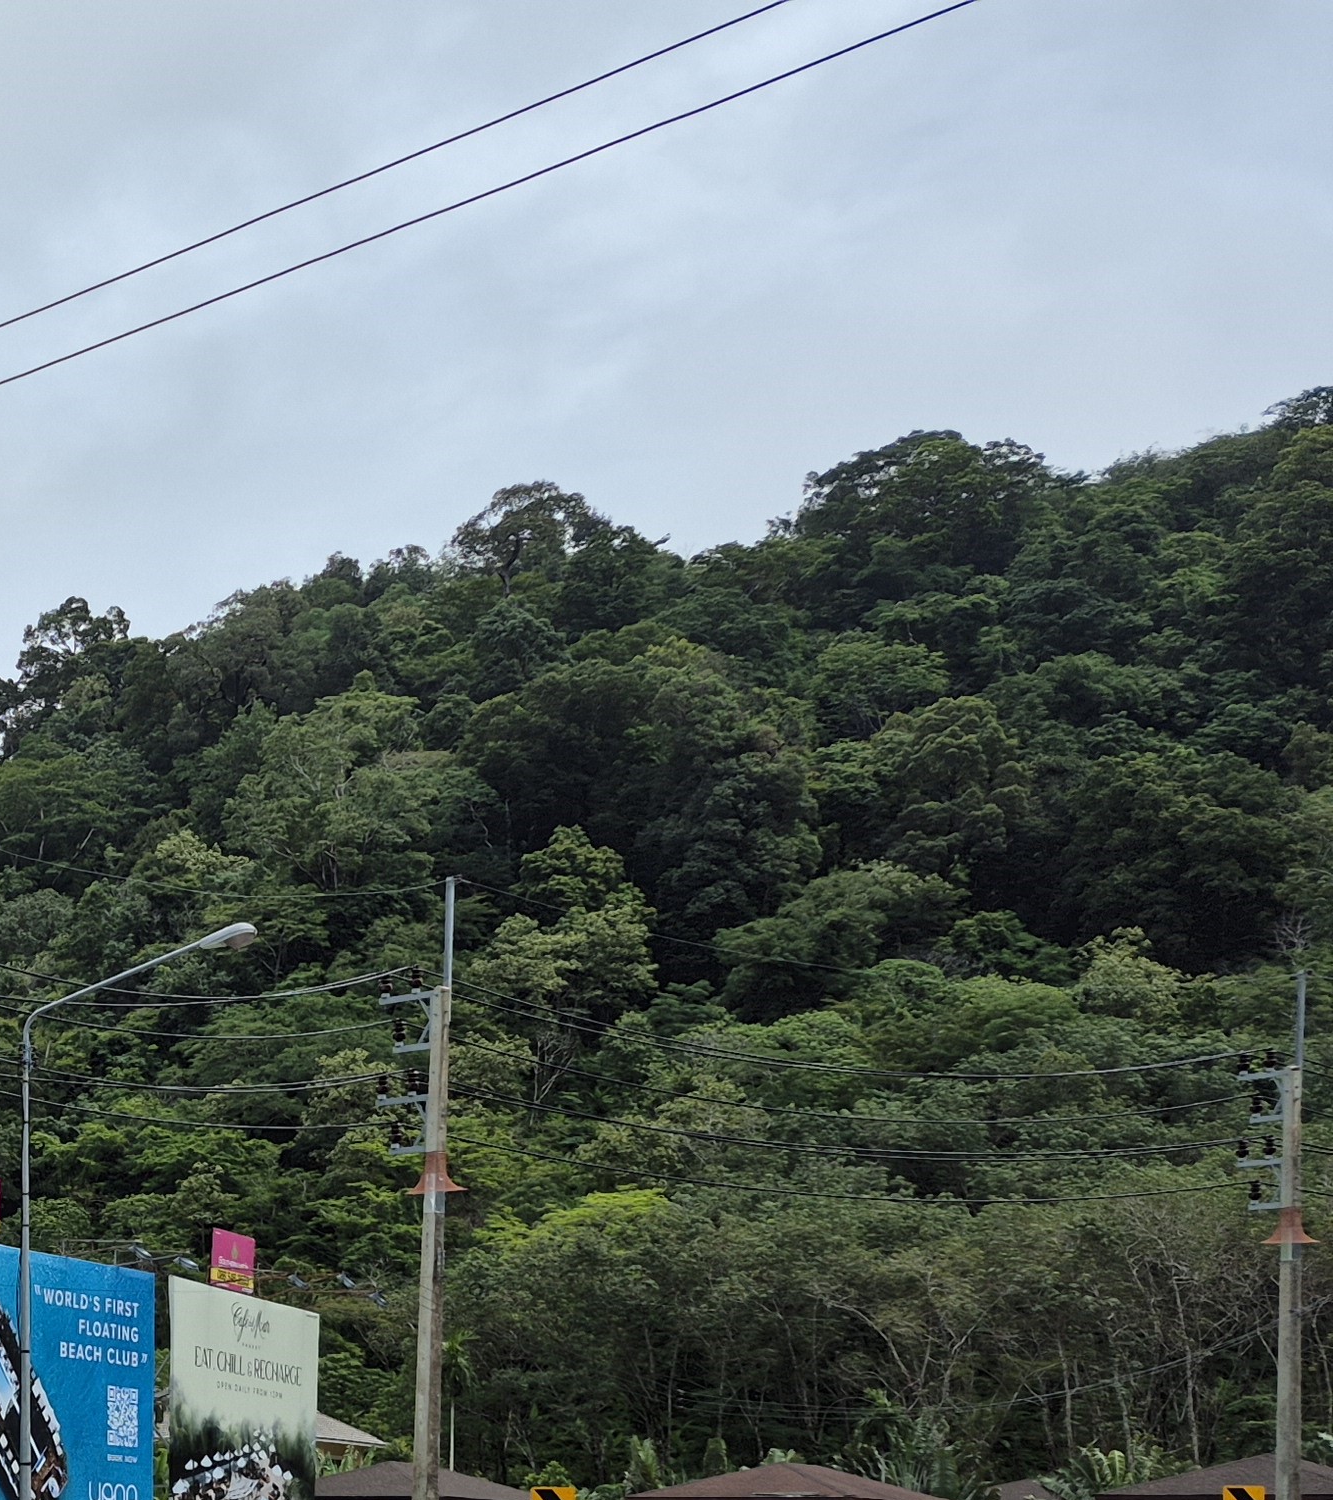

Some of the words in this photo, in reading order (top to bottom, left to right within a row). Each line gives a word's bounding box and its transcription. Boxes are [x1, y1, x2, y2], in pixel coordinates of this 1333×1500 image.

[105, 1298, 139, 1318] FIRST
[78, 1319, 139, 1343] FLOATING
[59, 1341, 102, 1362] BEACH
[216, 1350, 245, 1376] CHILL
[254, 1358, 302, 1387] RECHARGE
